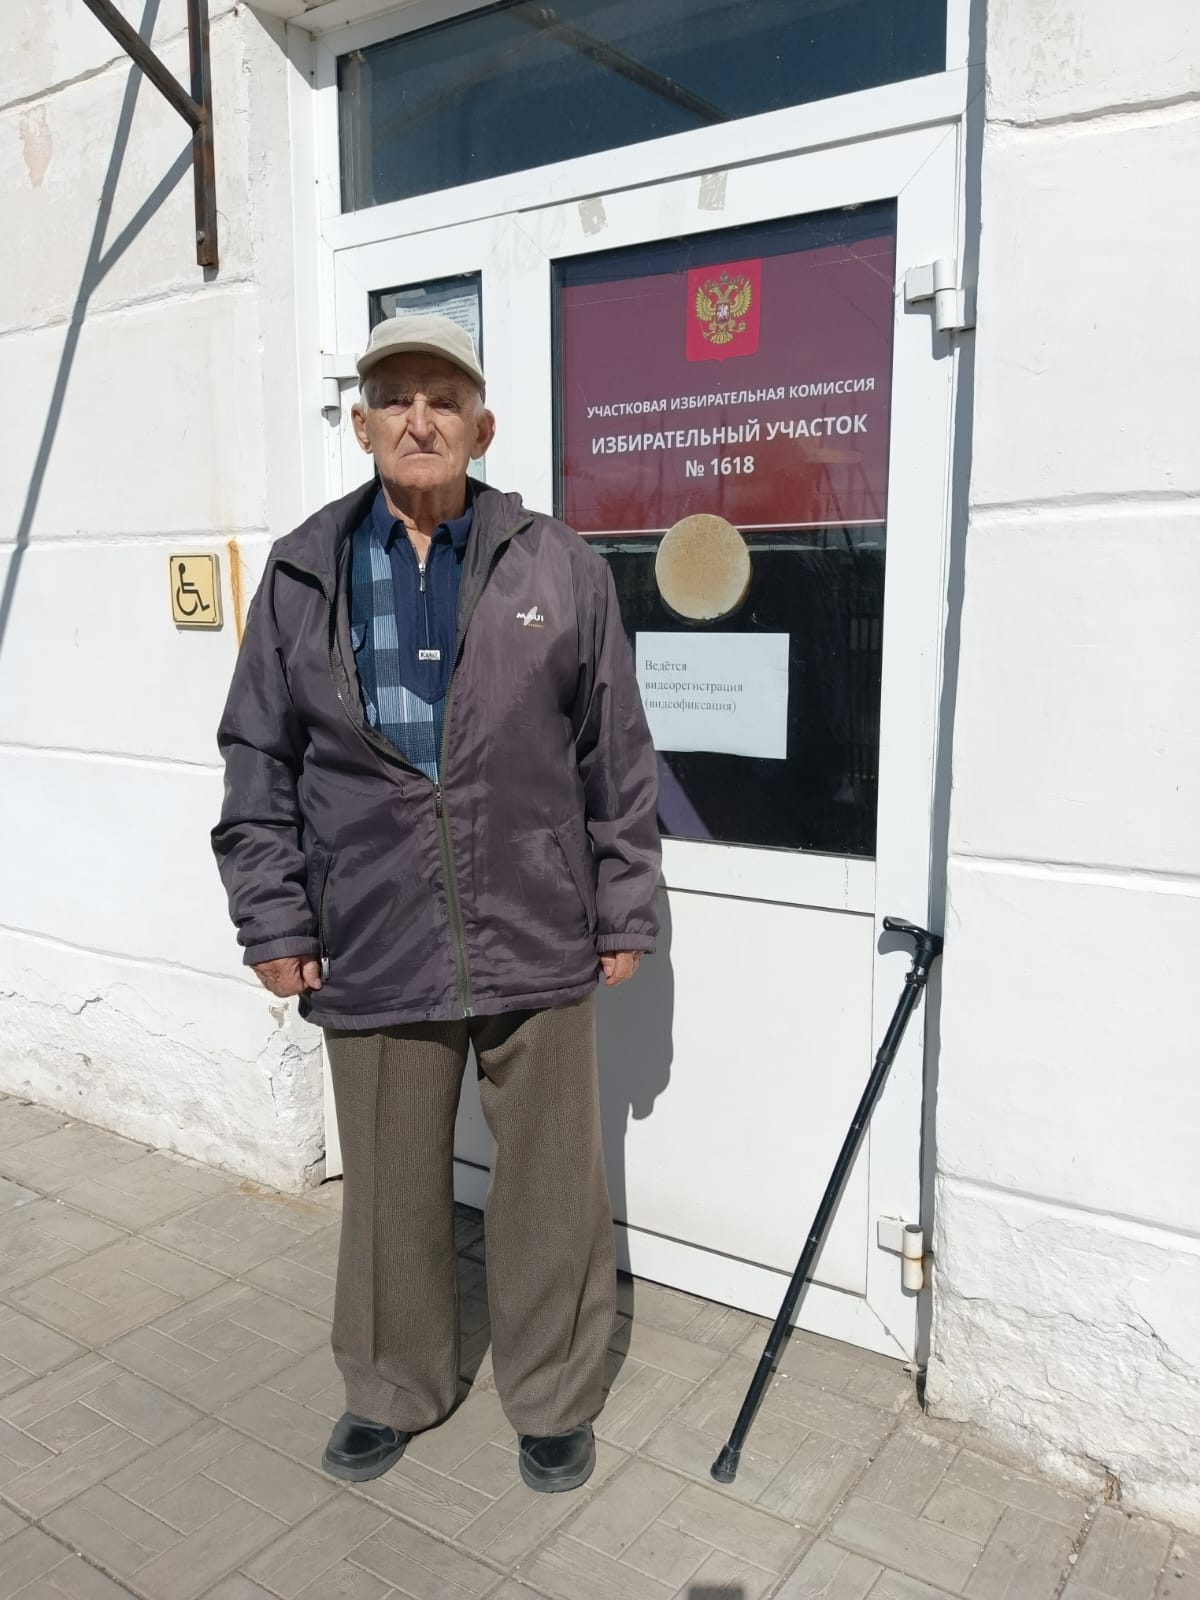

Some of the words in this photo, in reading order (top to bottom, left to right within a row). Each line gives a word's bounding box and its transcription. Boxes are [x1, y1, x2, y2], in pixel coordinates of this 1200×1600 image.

[587, 399, 667, 418] УЧАСТКОВАЯ
[670, 387, 785, 411] ИЗБИРАТЕЛЬНАЯ
[789, 377, 875, 398] КОМИССИЯ
[591, 419, 760, 455] ИЗБИРАТЕЛЬНЫЙ
[766, 414, 869, 440] УЧАСТОК
[685, 460, 705, 477] №
[710, 456, 755, 475] 1618
[645, 660, 687, 672] Ведётся
[645, 680, 743, 693] видеорегистрация
[645, 699, 737, 712] (видеофиксация)
